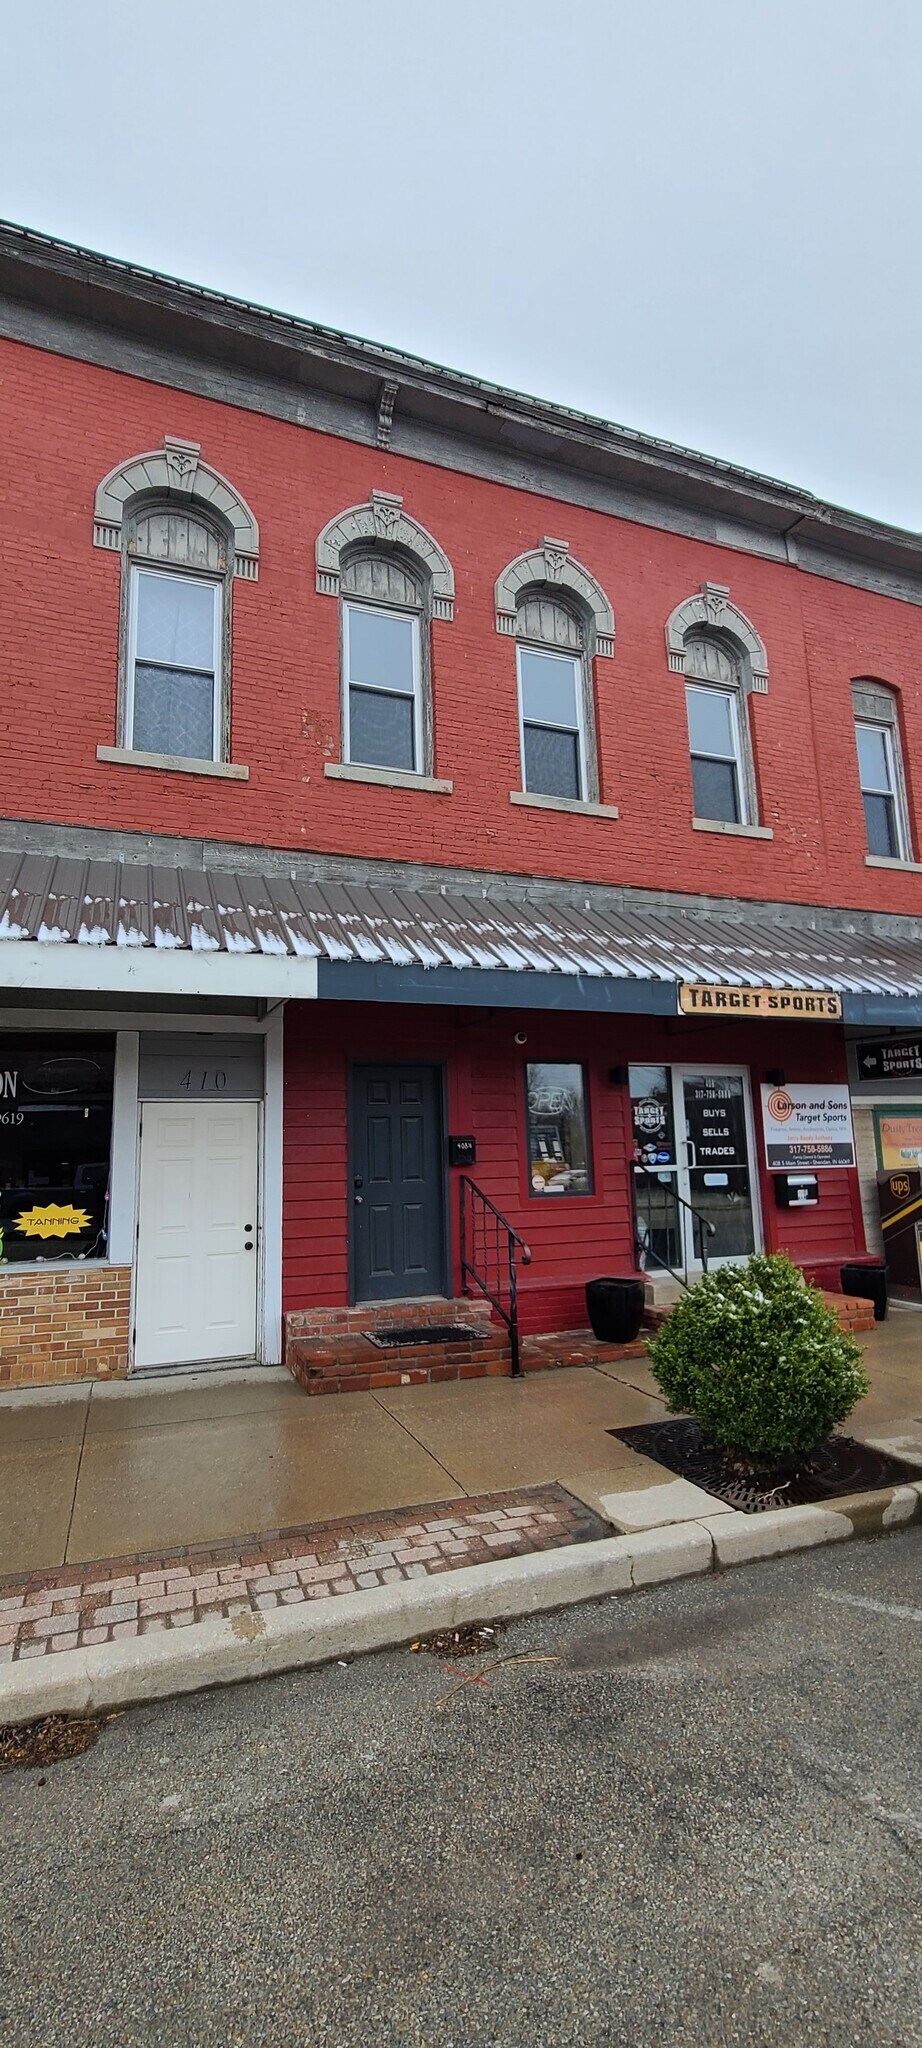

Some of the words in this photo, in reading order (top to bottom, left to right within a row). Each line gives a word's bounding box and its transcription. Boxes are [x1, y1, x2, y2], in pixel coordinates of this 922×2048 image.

[689, 989, 761, 1008] TARGET
[768, 996, 838, 1014] SPORTS
[881, 1045, 920, 1060] TARGET
[883, 1057, 922, 1072] SPORTS
[0, 1071, 18, 1098] N
[180, 1070, 226, 1090] 410
[528, 1092, 573, 1110] OPEN
[777, 1101, 806, 1110] Larson
[809, 1100, 825, 1110] and
[828, 1100, 848, 1110] Sons
[633, 1106, 664, 1116] TARGET
[703, 1109, 726, 1118] BUYS
[0, 1111, 24, 1127] 619
[634, 1116, 666, 1126] SPORTS
[795, 1113, 821, 1124] Target
[823, 1113, 847, 1123] Sports
[703, 1128, 729, 1137] SELLS
[700, 1147, 735, 1156] TRADES
[892, 1180, 909, 1195] ups
[27, 1217, 80, 1226] TANNING
